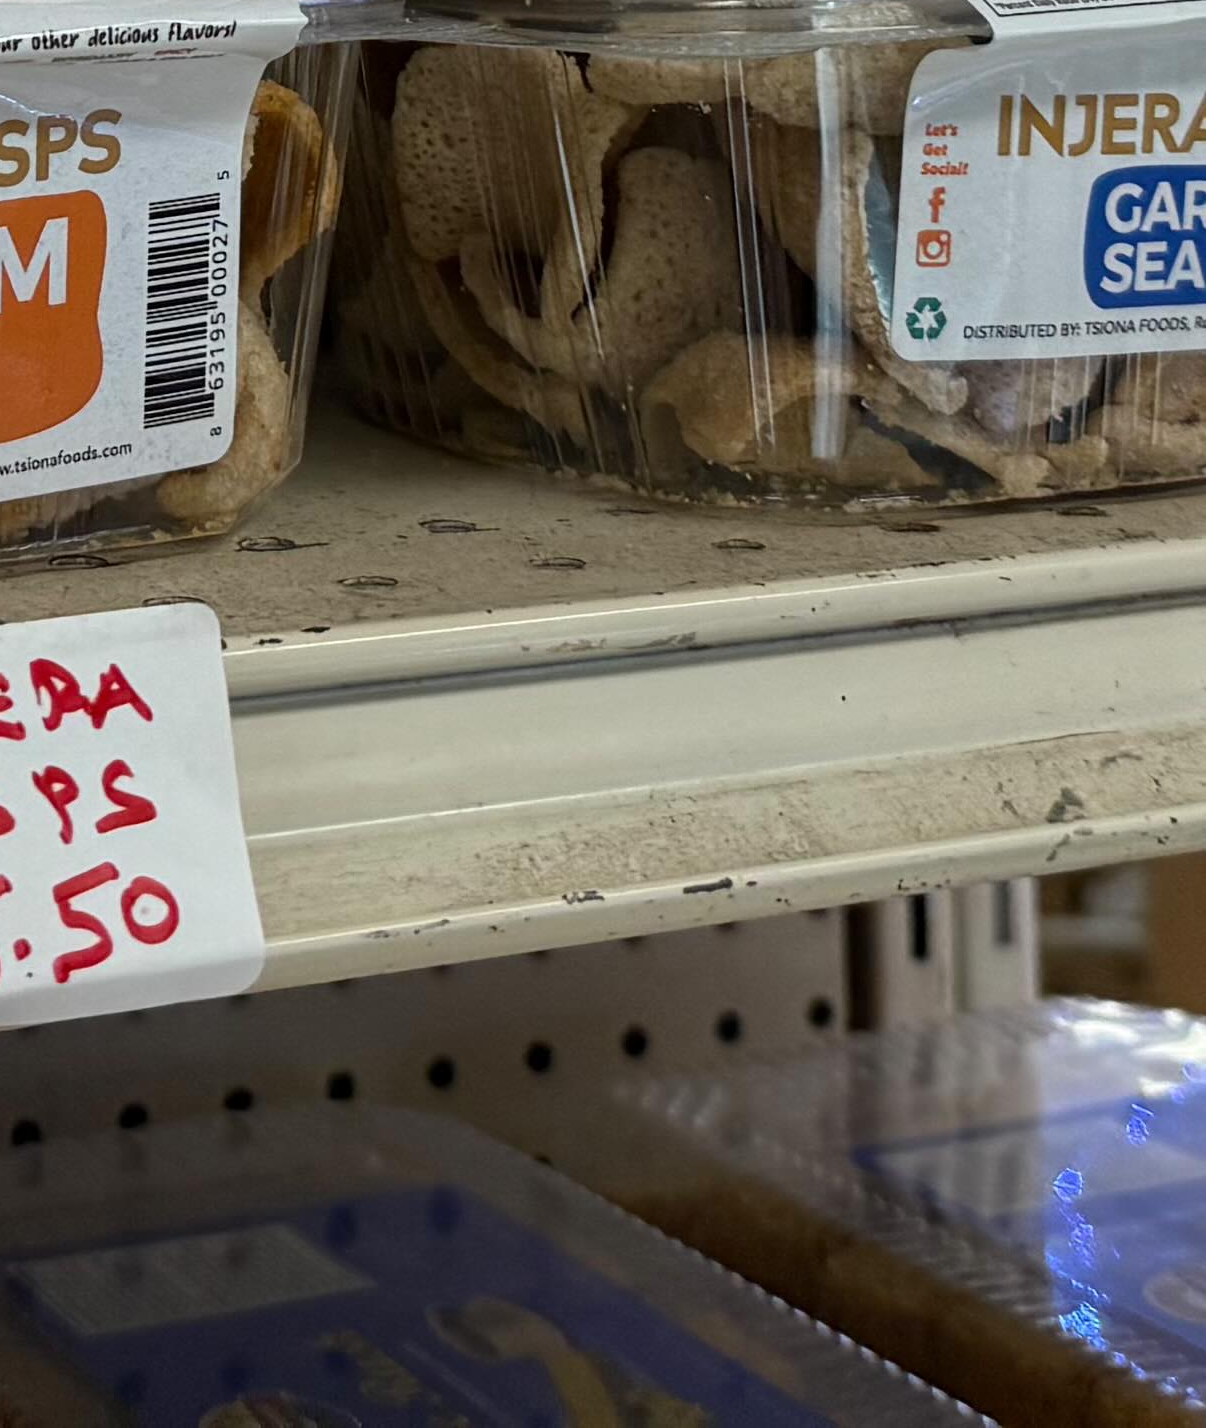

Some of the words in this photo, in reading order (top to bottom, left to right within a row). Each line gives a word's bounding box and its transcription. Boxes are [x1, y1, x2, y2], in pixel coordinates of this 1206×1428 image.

[31, 29, 80, 52] other
[88, 26, 159, 47] delicious
[167, 21, 238, 43] flavors!
[924, 122, 959, 138] Let's
[922, 142, 948, 158] Get
[1099, 239, 1206, 295] SEA
[962, 322, 1058, 340] DISTRIBUTED
[1084, 318, 1136, 336] TSIONA
